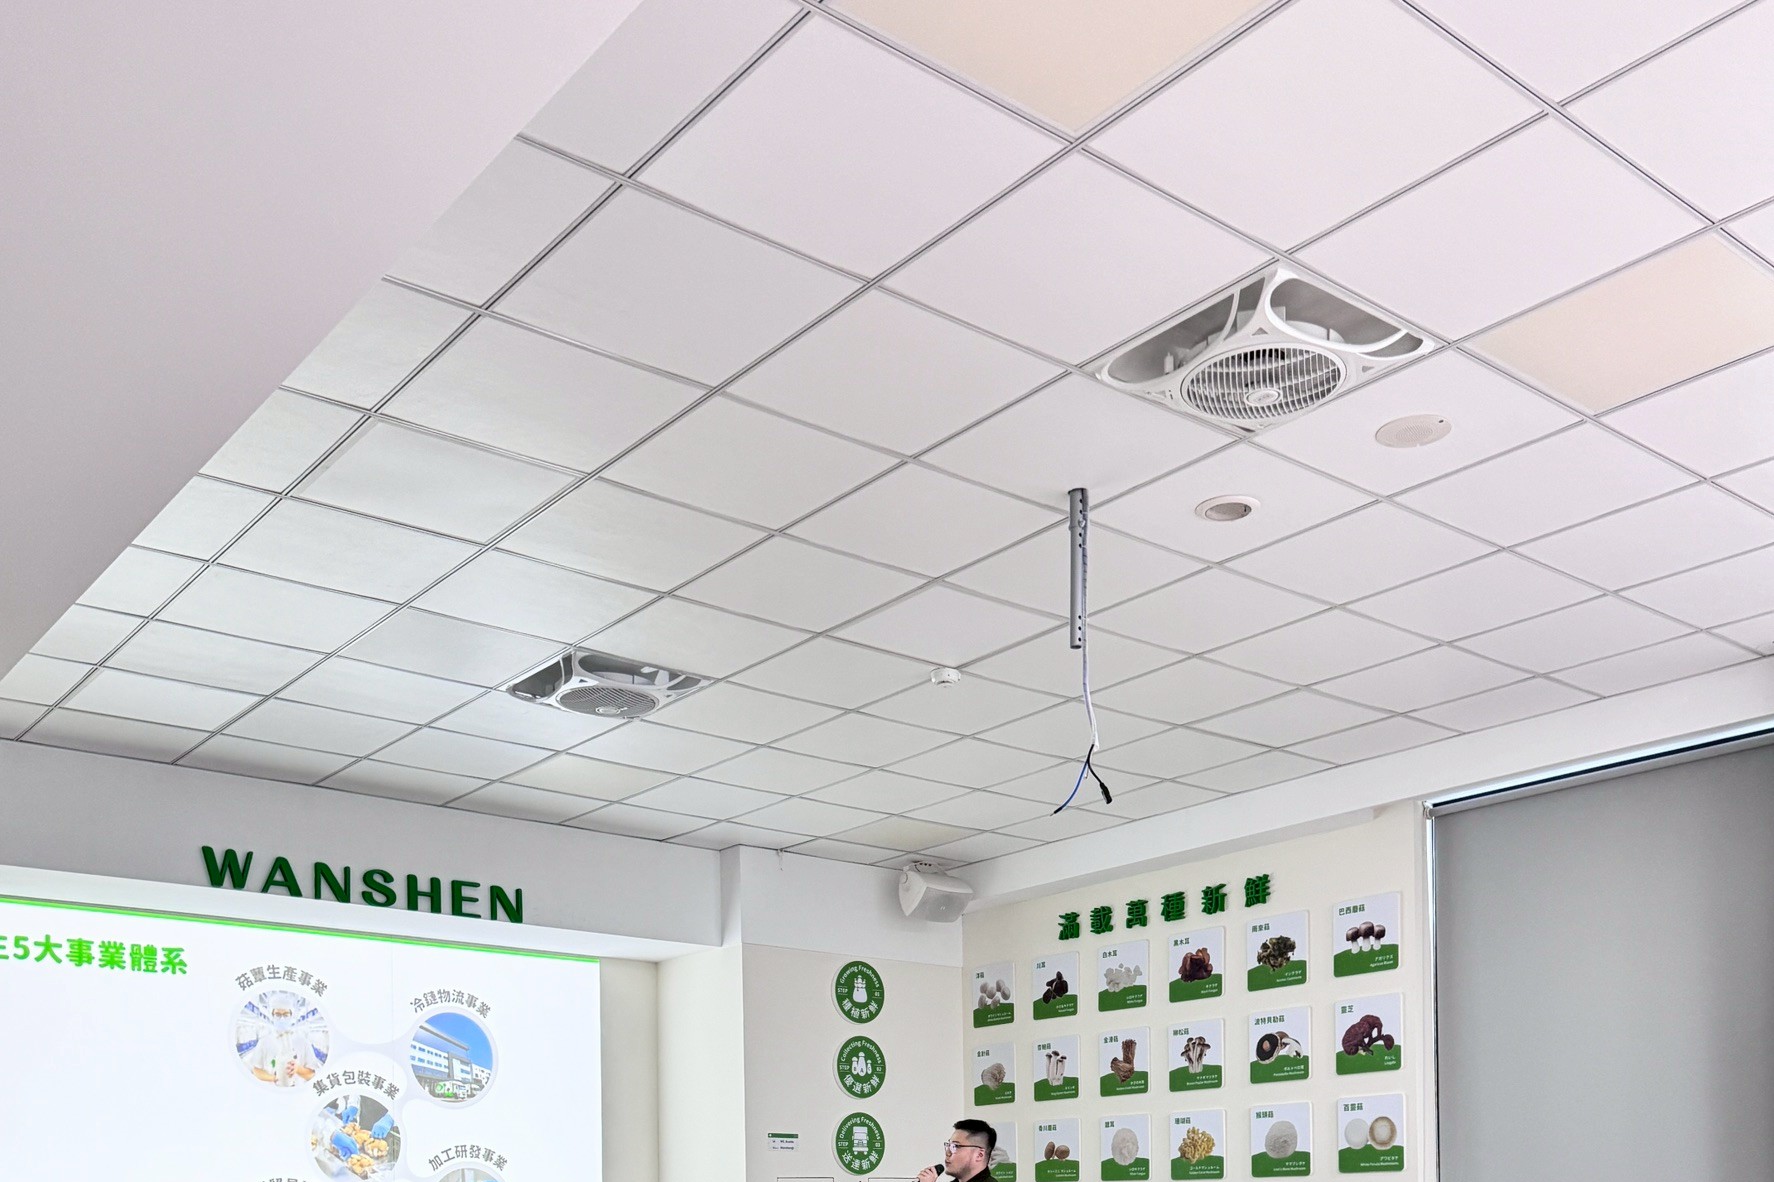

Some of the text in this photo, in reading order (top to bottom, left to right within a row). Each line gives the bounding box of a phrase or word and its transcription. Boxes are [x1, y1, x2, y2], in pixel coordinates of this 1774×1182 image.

[202, 846, 523, 923] WANSHEN
[1058, 874, 1271, 940] 滿載萬種新鮮
[235, 964, 328, 997] 菇蕈生產事業
[840, 965, 880, 988] Growing Freshness
[410, 988, 491, 1019] 冷鏈物流事業
[841, 1040, 881, 1063] Collecting Freshness
[313, 1070, 400, 1100] 集貨包裝事業
[840, 1116, 881, 1140] Delivering Freshness
[428, 1144, 508, 1171] 加工研發事業
